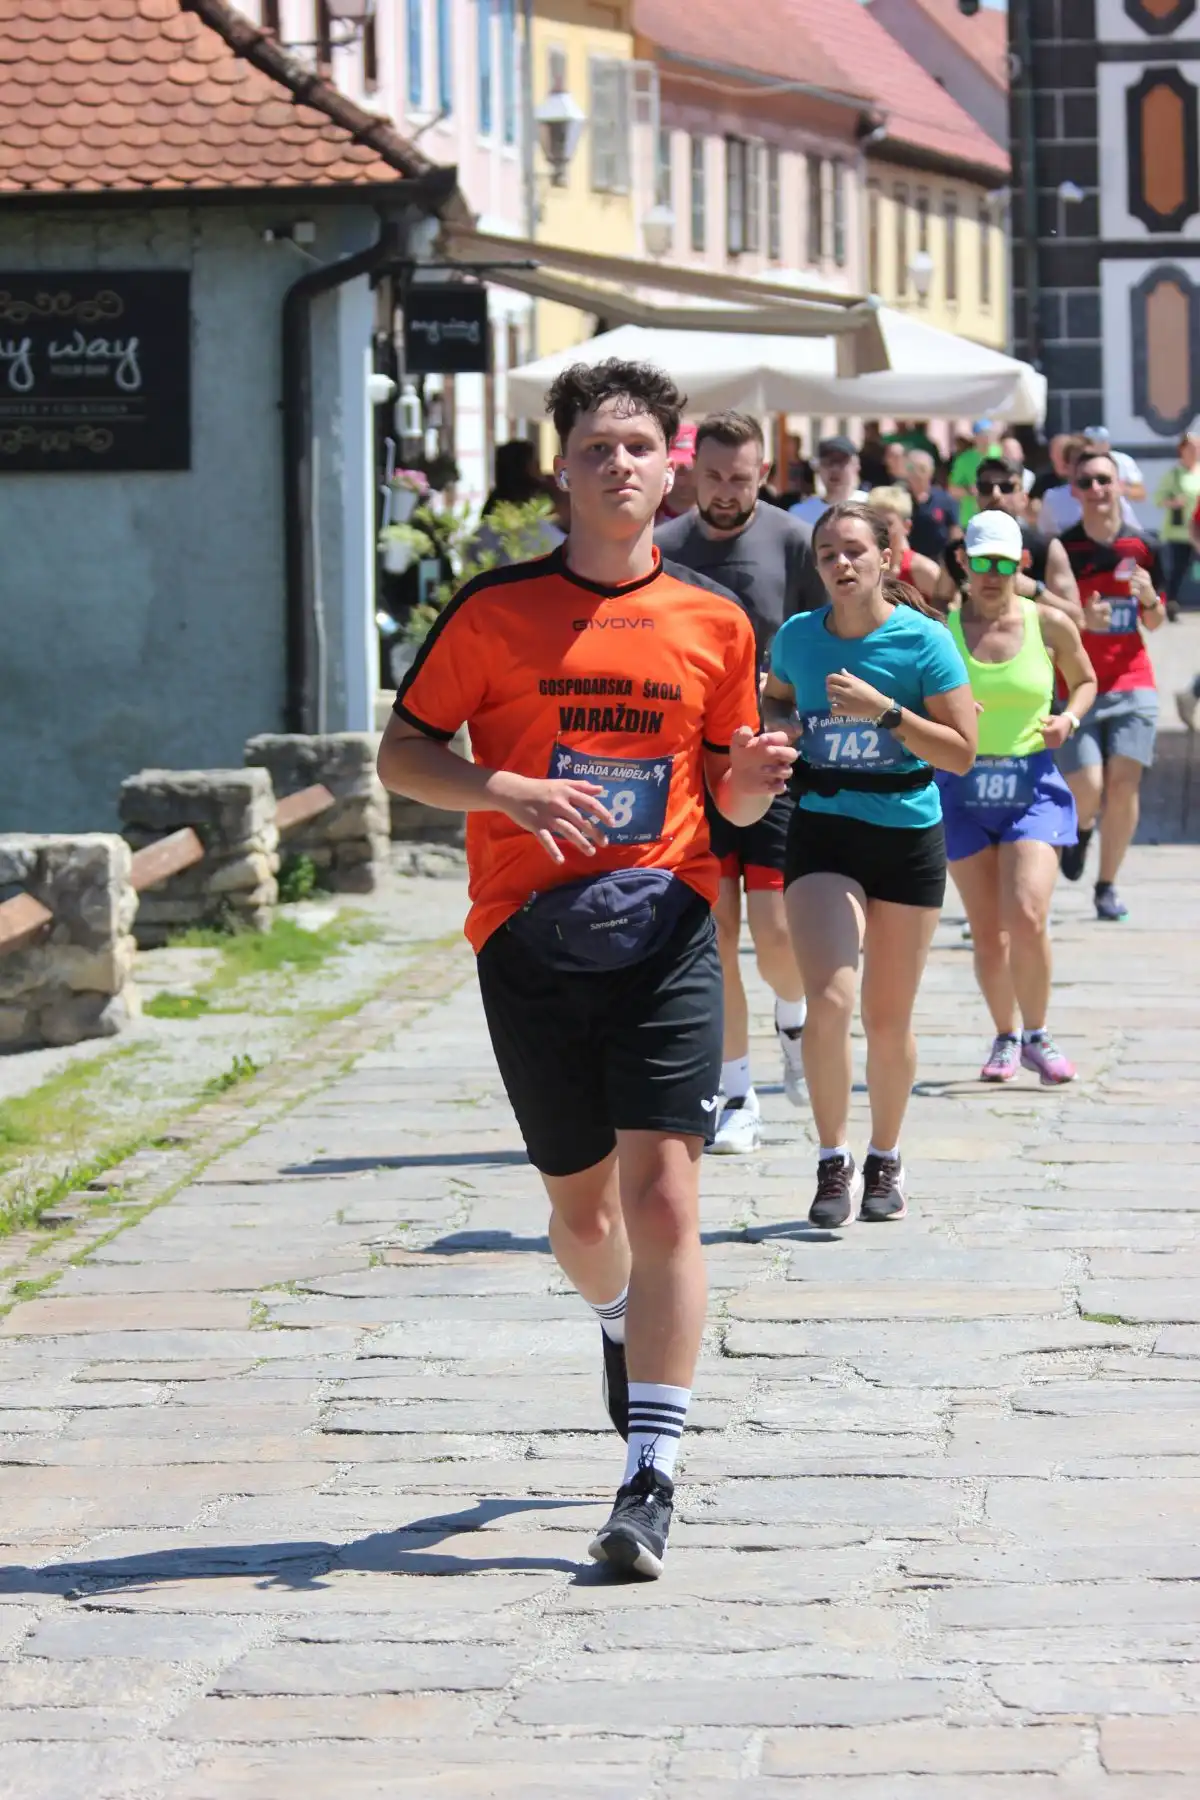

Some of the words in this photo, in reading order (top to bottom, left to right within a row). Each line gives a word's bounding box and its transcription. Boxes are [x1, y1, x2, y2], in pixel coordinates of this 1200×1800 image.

[0, 337, 35, 392] y
[48, 328, 142, 392] way
[572, 617, 655, 631] GIVOVA
[539, 677, 632, 696] GOSPODARSKA
[643, 678, 682, 701] ŠKOLA
[559, 702, 664, 734] VARAŽDIN
[824, 730, 880, 762] 742
[573, 763, 608, 776] GRADA
[976, 773, 1018, 800] 181
